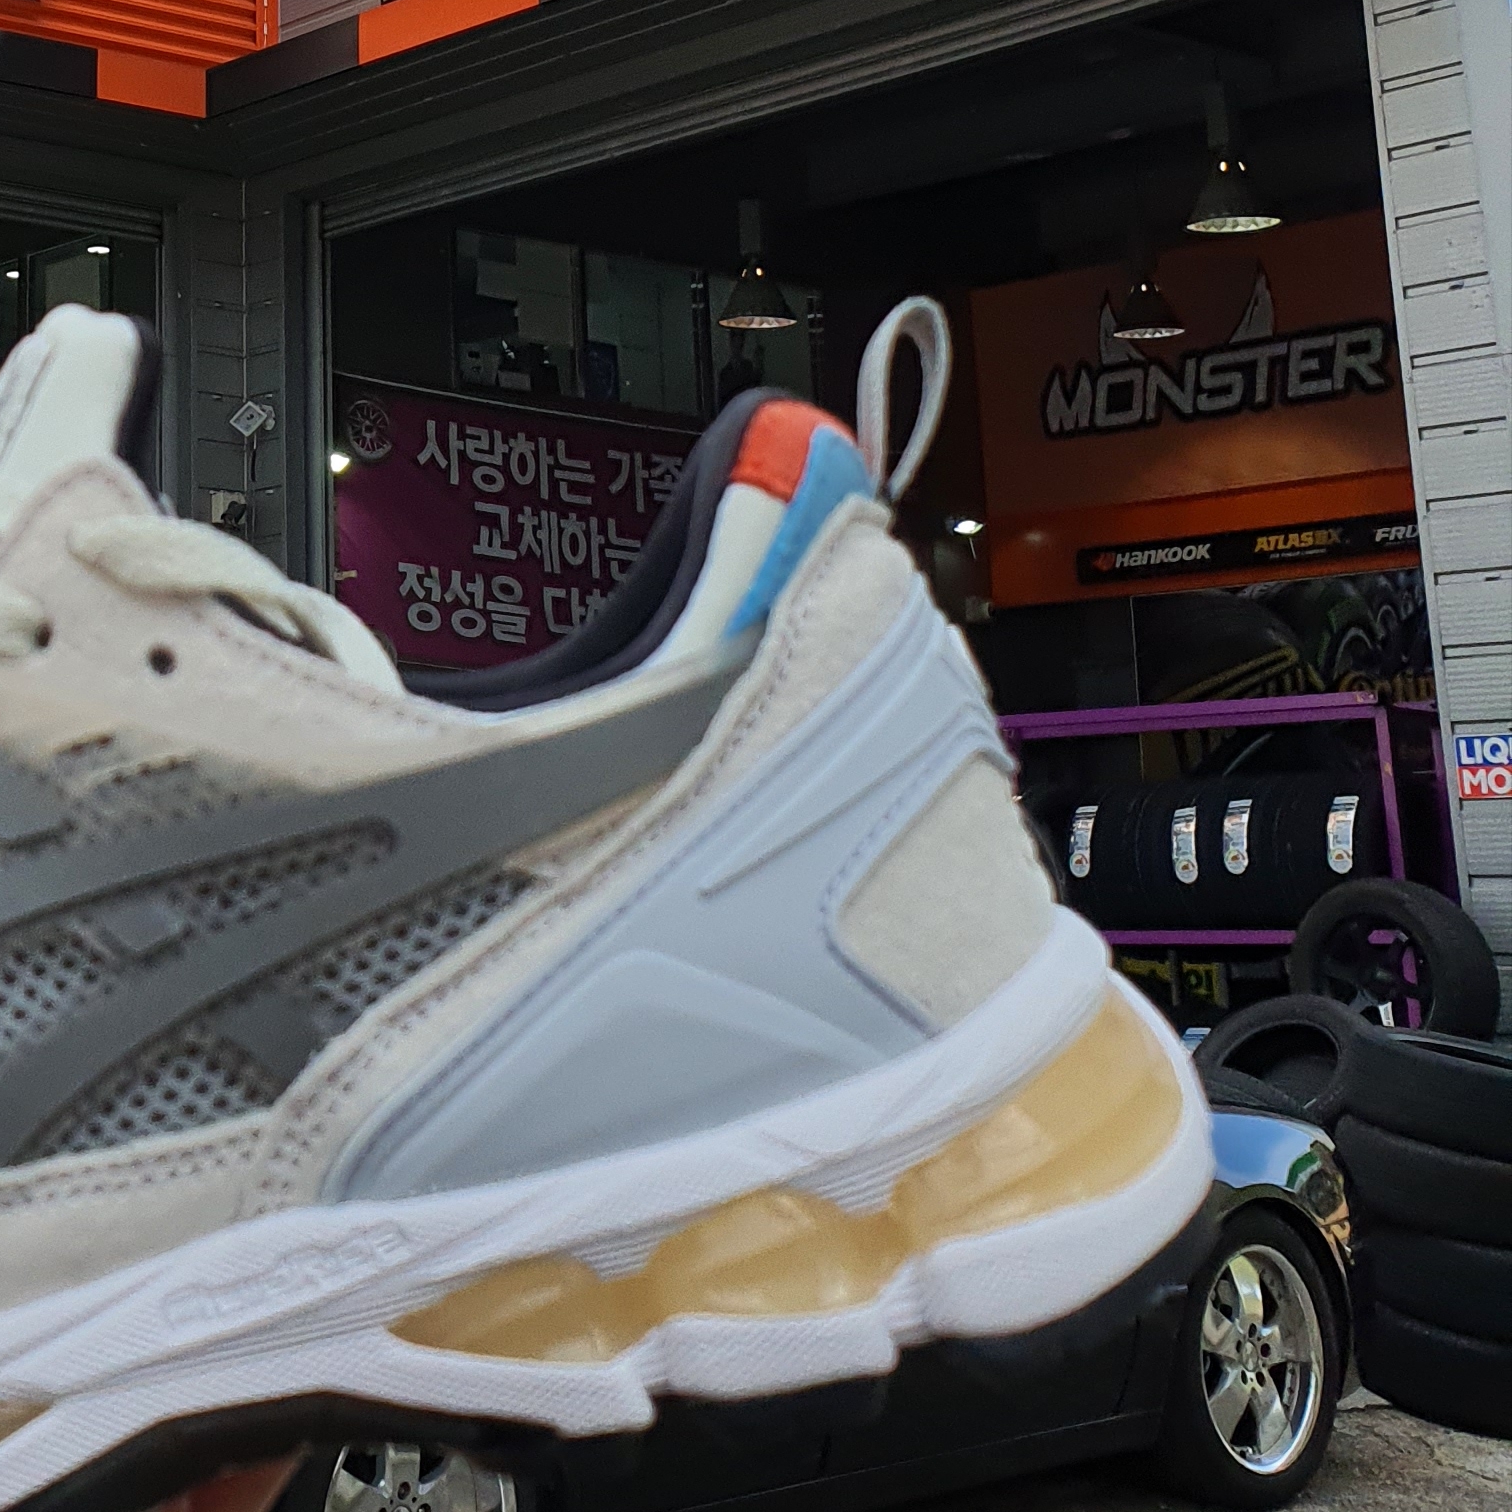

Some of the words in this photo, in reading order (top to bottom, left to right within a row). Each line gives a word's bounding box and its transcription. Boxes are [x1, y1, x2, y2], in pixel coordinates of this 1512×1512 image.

[1044, 325, 1385, 437] MONSTER
[417, 419, 597, 505] 사랑하는
[472, 500, 641, 585] 교체하는
[398, 561, 531, 645] 정성을
[1458, 736, 1512, 766] LIQ
